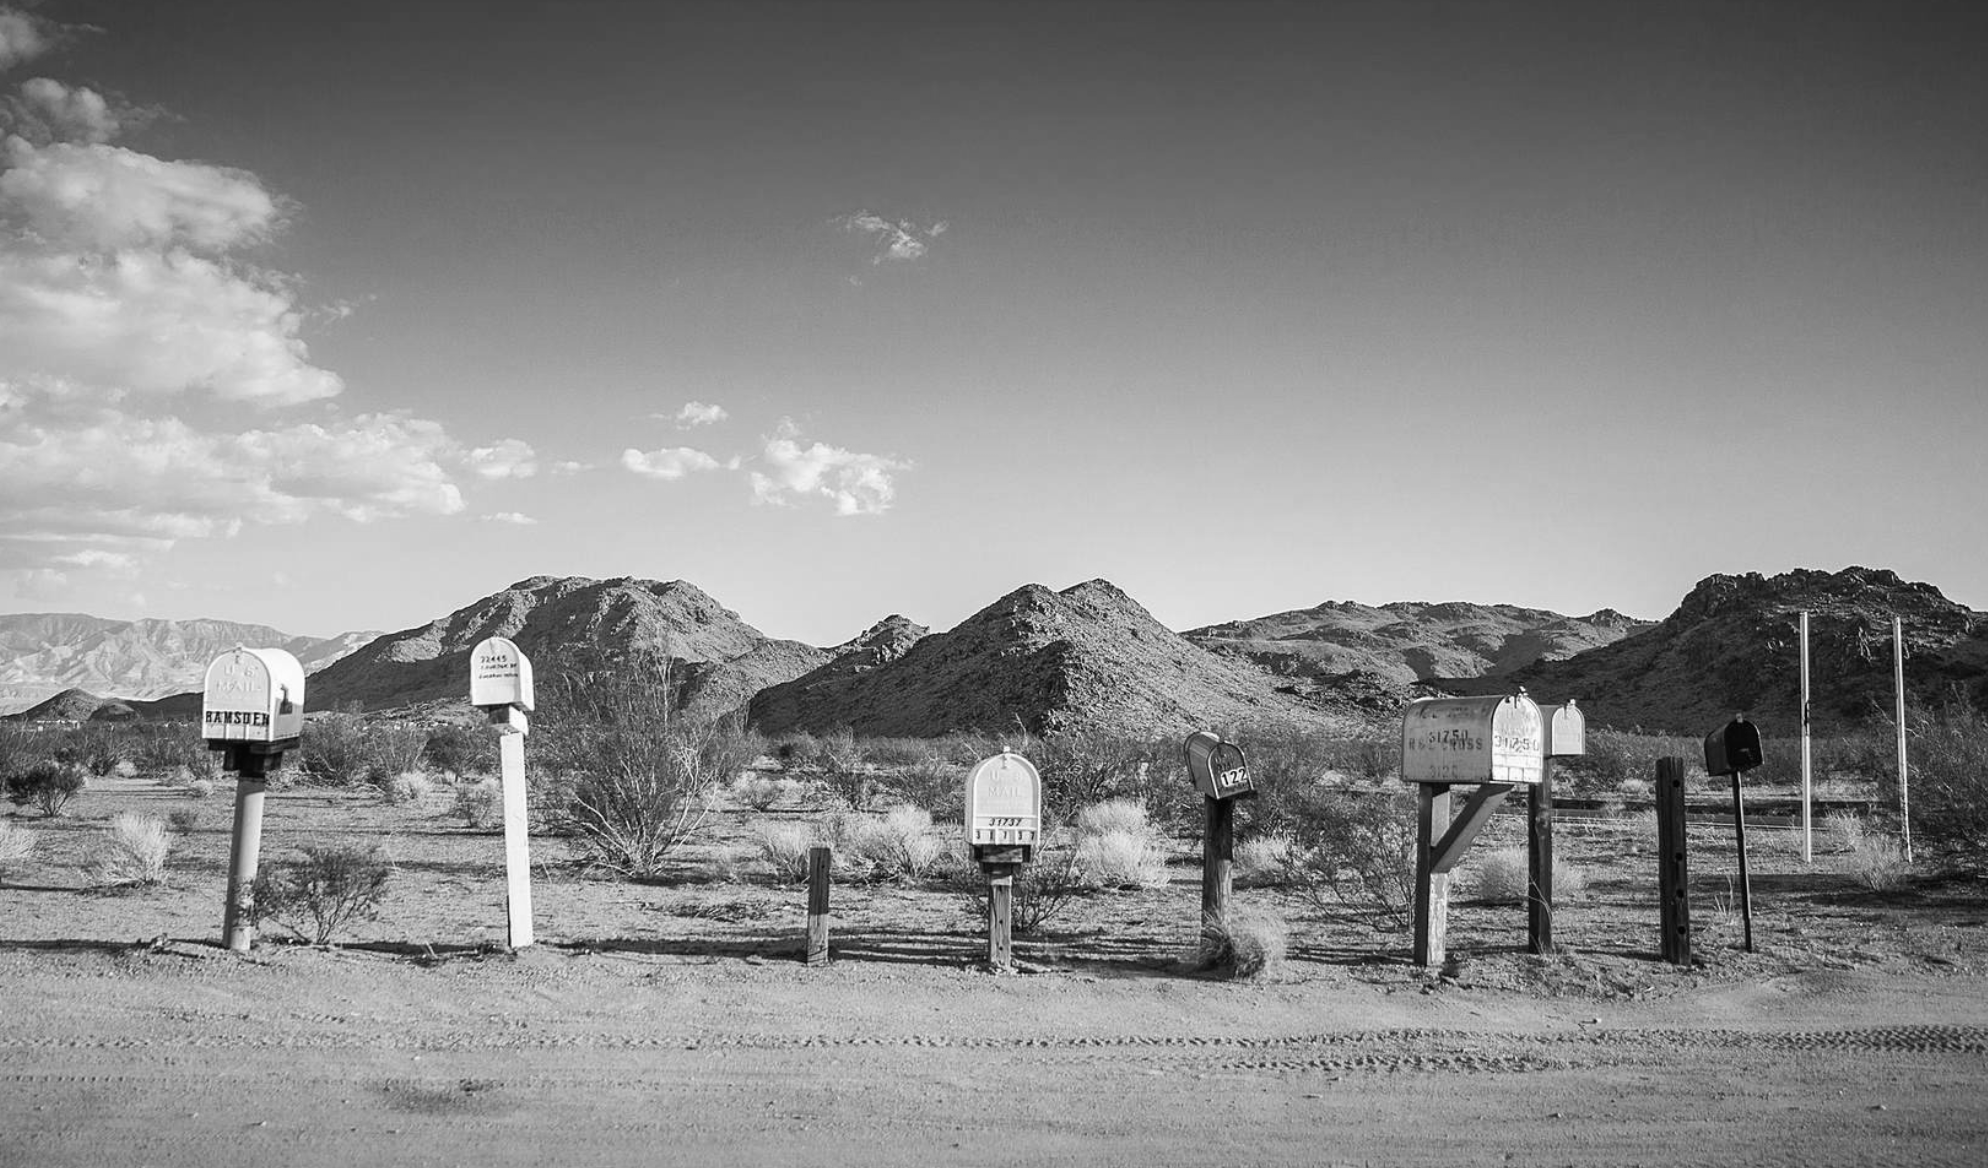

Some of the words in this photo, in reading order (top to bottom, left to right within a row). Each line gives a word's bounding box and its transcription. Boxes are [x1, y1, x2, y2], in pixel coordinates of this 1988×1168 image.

[205, 710, 270, 726] RAMSDEN
[1221, 768, 1246, 785] 122
[988, 786, 1022, 798] MAIL
[989, 817, 1022, 827] 31737
